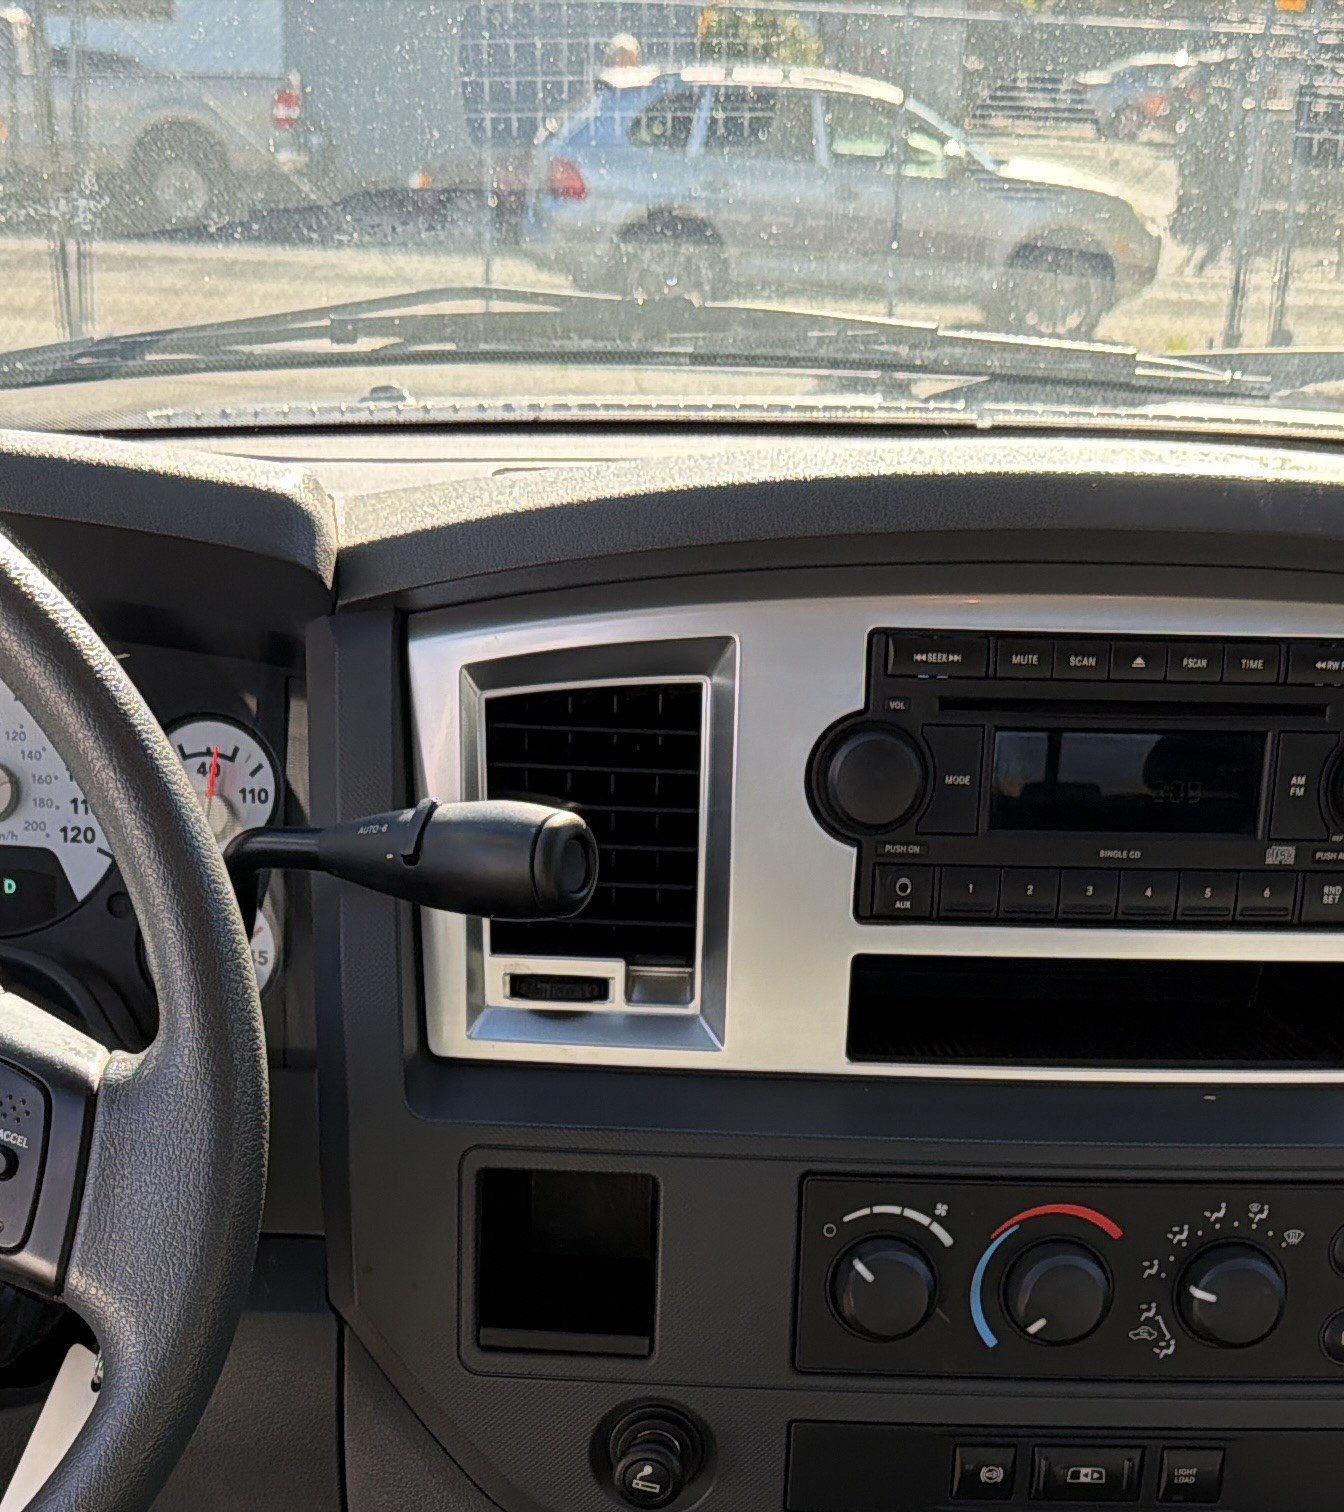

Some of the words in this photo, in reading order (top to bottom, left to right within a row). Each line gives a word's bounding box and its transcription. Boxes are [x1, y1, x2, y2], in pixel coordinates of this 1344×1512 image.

[927, 653, 948, 663] SEEK
[1012, 654, 1038, 665] MUTE
[1070, 656, 1096, 667] SCAN
[1241, 658, 1264, 670] TIME
[889, 701, 905, 710] VOL
[5, 730, 27, 742] 120
[21, 749, 43, 761] 140
[31, 773, 53, 786] 160
[945, 775, 970, 785] MODE
[1290, 776, 1306, 786] AM
[239, 787, 269, 804] 110
[1290, 787, 1305, 797] FM
[32, 797, 54, 810] 180
[70, 797, 89, 815] 11
[24, 820, 47, 833] 200
[59, 826, 96, 844] 120
[885, 845, 906, 854] PUSH
[1315, 851, 1337, 861] PUSH
[4, 879, 16, 894] D
[1027, 885, 1034, 895] 2
[1086, 885, 1093, 895] 3
[1145, 887, 1152, 897] 4
[895, 901, 911, 909] AUX
[1174, 1467, 1198, 1476] LIGHT
[1174, 1476, 1196, 1484] LOAD
